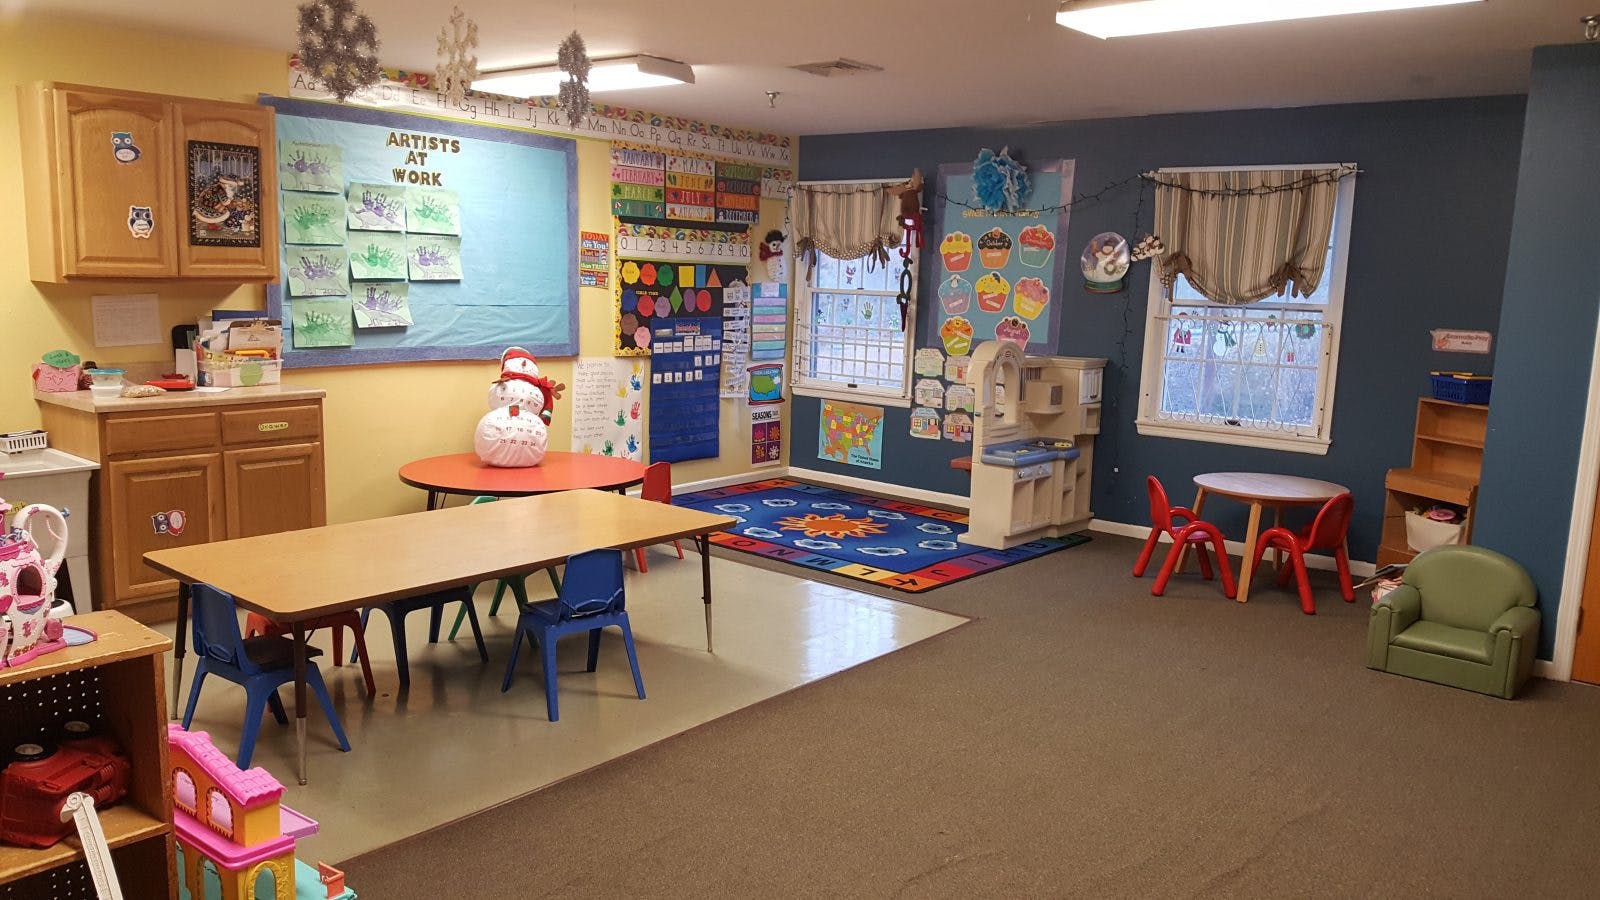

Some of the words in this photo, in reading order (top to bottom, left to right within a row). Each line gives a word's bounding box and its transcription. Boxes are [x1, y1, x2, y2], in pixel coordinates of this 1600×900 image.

[293, 74, 316, 91] Aa
[484, 100, 500, 117] Hh
[525, 107, 537, 128] Jj
[547, 110, 560, 126] Kk
[588, 118, 607, 133] Mm
[612, 121, 627, 136] Nn
[630, 123, 645, 138] Oo
[650, 127, 662, 146] Pp
[687, 134, 697, 147] Rr
[702, 138, 711, 150] Ss
[731, 142, 742, 155] Uu
[747, 143, 756, 156] Vv
[761, 145, 775, 160] Ww
[780, 148, 790, 161] Xx
[386, 131, 461, 153] ARTISTS
[405, 150, 428, 166] AT
[622, 150, 655, 167] JANUARY
[682, 158, 699, 173] MAY
[392, 167, 442, 187] WORK
[621, 168, 656, 184] FEBRUARY
[681, 174, 702, 191] JUNE
[624, 185, 651, 201] MARCH
[681, 190, 701, 205] JULY
[725, 209, 755, 222] DECEMBER
[582, 232, 608, 242] TODAY
[593, 240, 608, 250] You!
[620, 237, 628, 250] 0
[647, 239, 653, 252] 2
[660, 240, 666, 253] 3
[672, 241, 679, 254] 4
[685, 241, 692, 254] 5
[698, 242, 704, 255] 6
[709, 243, 715, 255] 7
[717, 244, 723, 256] 8
[728, 244, 734, 256] 9
[739, 245, 748, 257] 10
[751, 410, 773, 420] SEASONS
[894, 577, 919, 588] K
